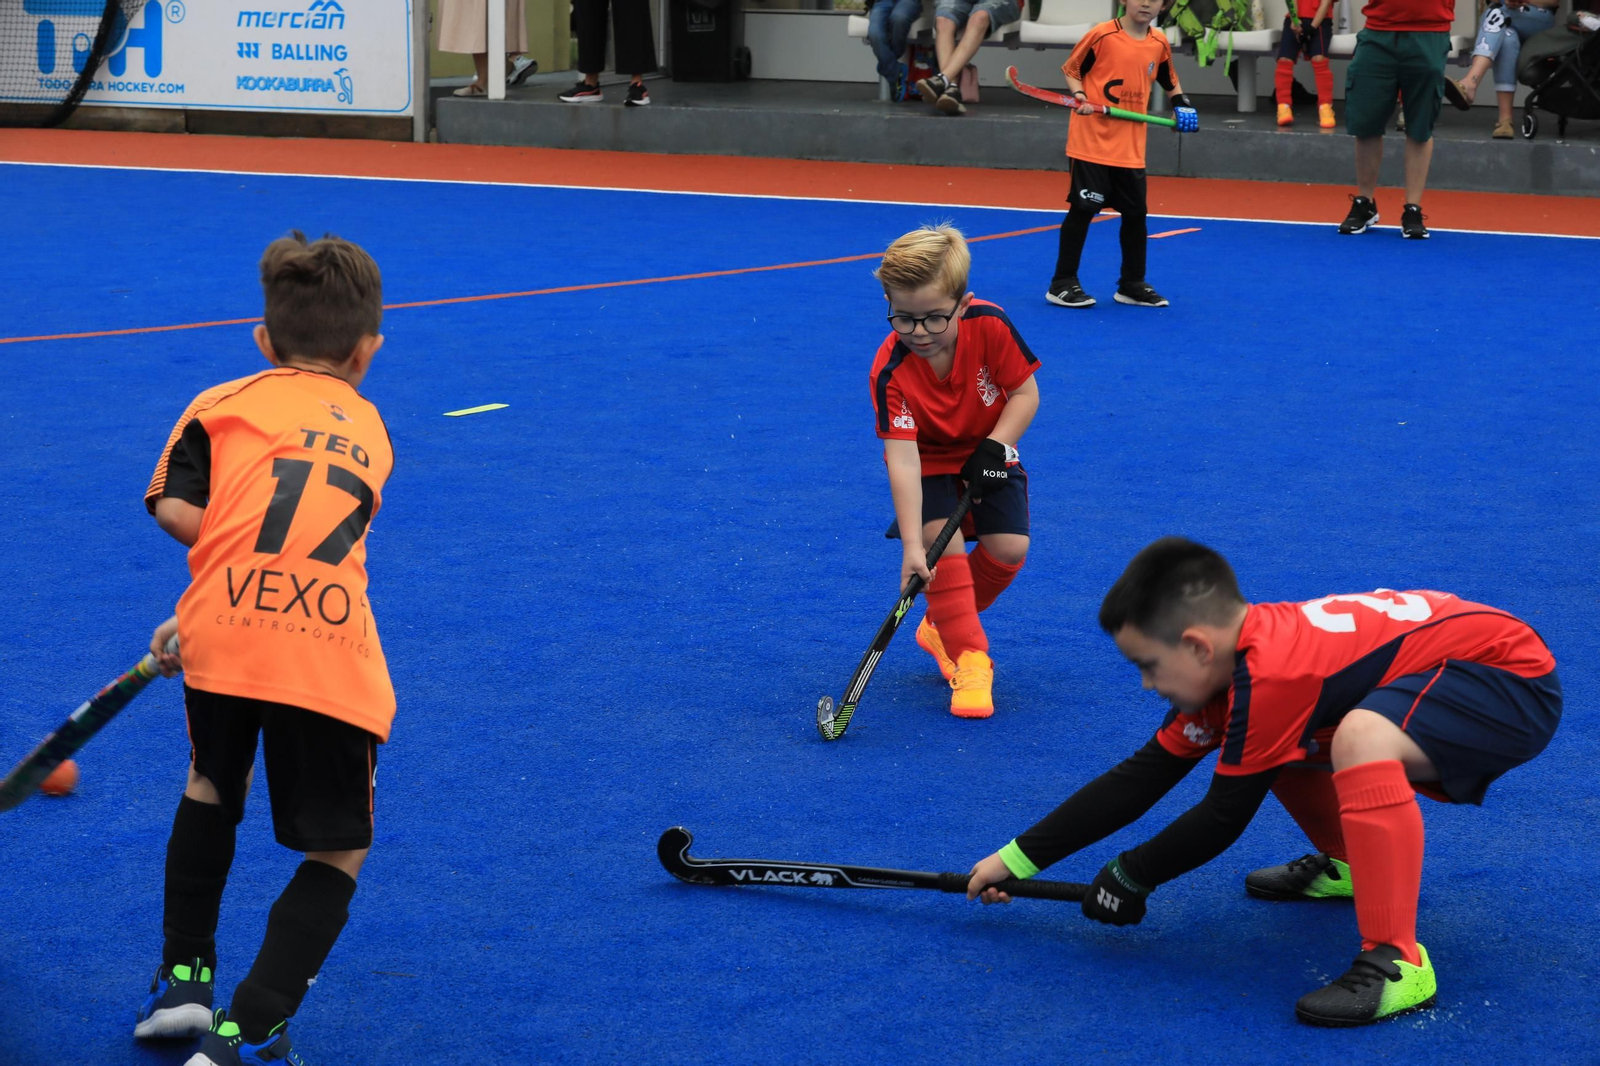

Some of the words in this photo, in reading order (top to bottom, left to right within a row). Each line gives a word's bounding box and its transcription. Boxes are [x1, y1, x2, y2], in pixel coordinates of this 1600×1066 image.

[237, 11, 345, 29] mercian
[271, 43, 348, 61] BALLING
[38, 78, 71, 90] TODO
[108, 81, 186, 94] HOCKEY.COM
[236, 75, 336, 92] KOOKABURRA
[300, 428, 370, 469] TEO
[253, 457, 374, 567] 17
[215, 614, 296, 633] CENTRO
[728, 869, 809, 884] VLACK
